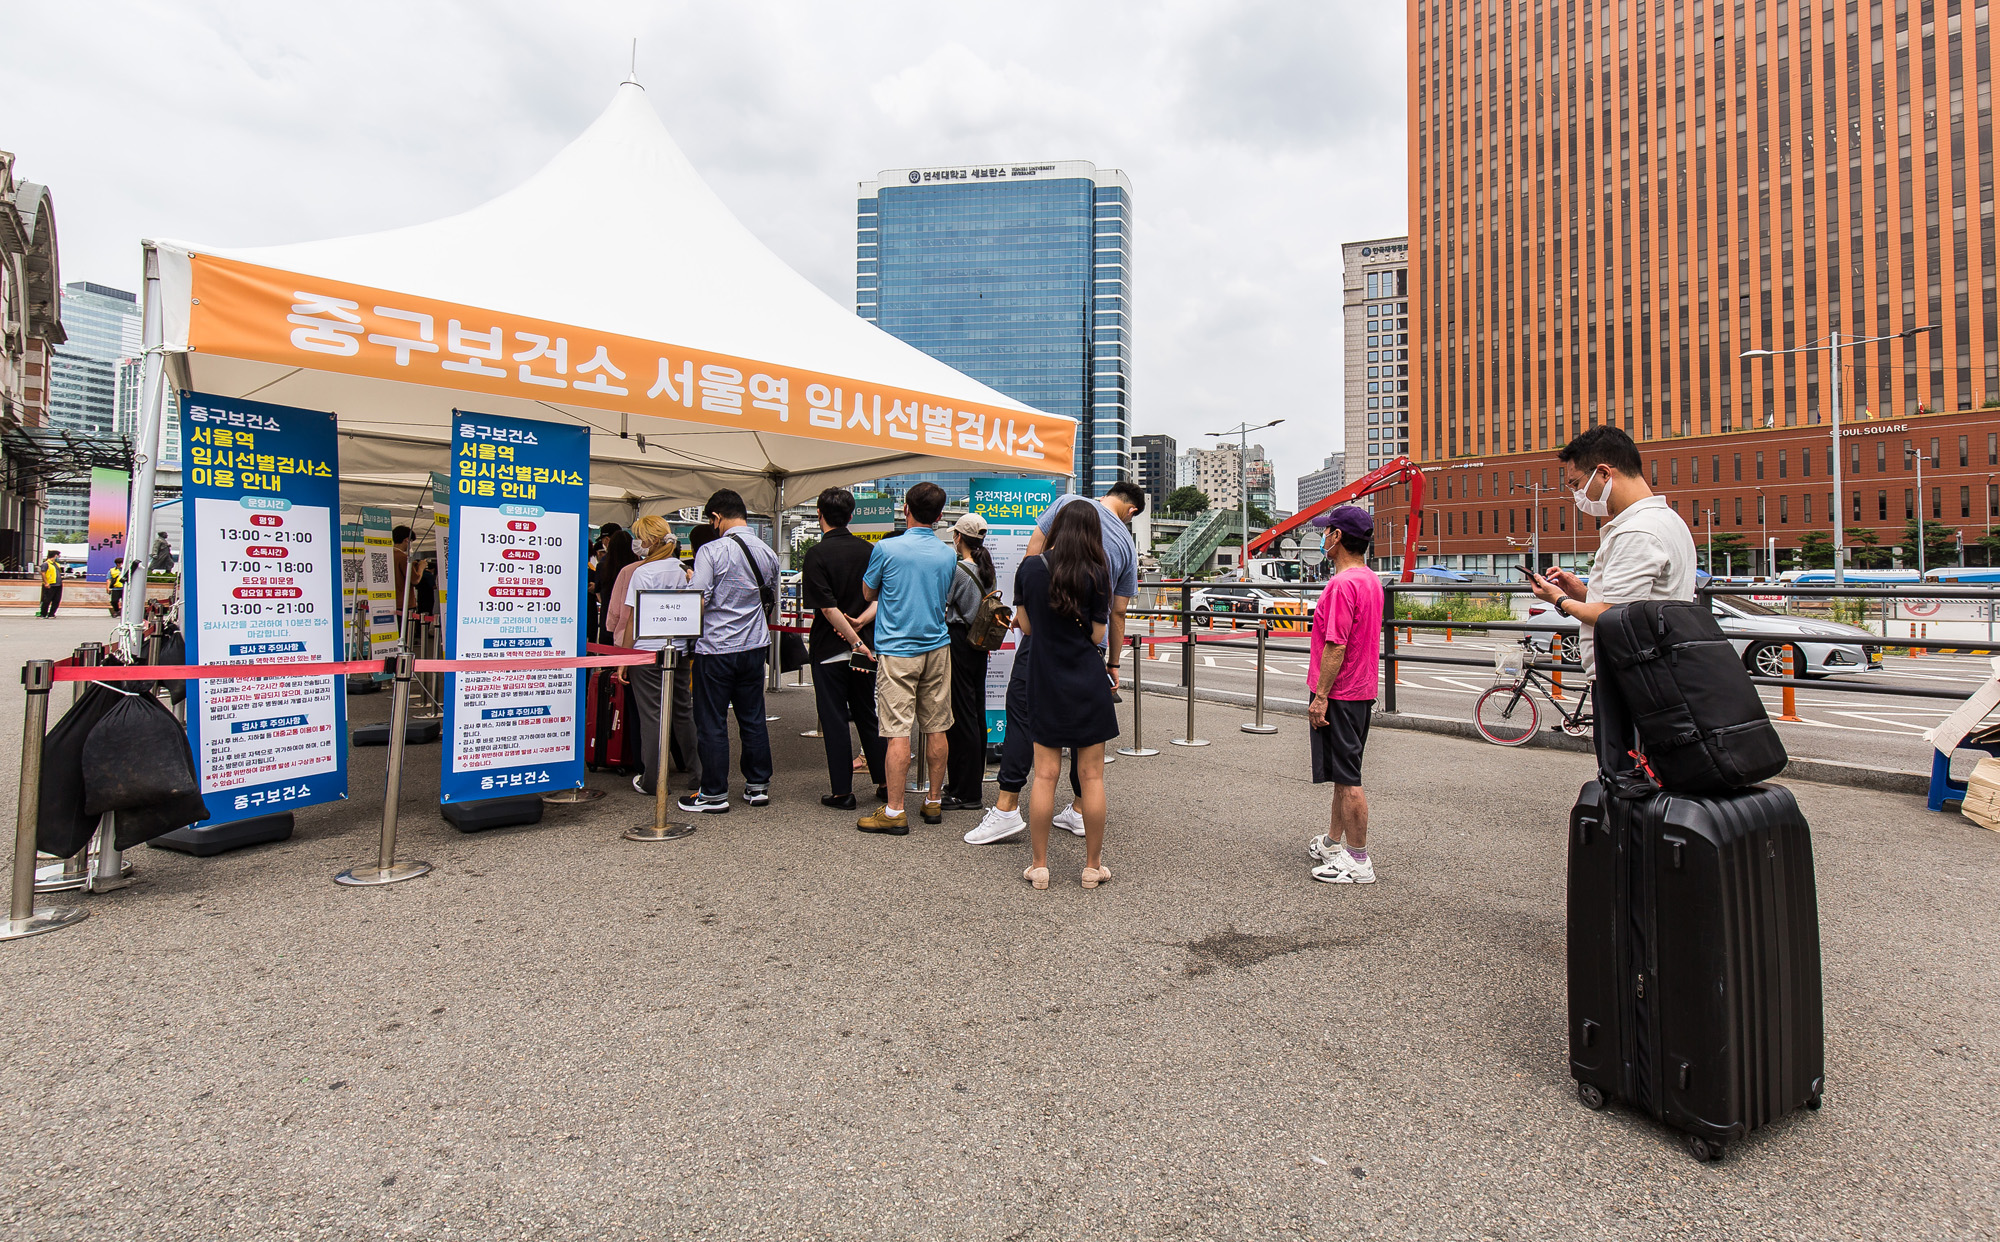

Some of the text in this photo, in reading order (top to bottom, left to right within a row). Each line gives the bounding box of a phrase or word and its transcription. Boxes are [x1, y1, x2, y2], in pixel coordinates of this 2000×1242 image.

[922, 168, 1006, 182] 연세대학교 세브란스
[288, 291, 1047, 462] 중구보건소 서울역 임시선별검사소
[190, 405, 280, 432] 중구보건소
[459, 424, 538, 445] 중구보건소
[1829, 424, 1908, 438] SOUL SQUARE
[190, 426, 254, 450] 서울역
[459, 442, 514, 462] 서울역
[190, 446, 333, 478] 임시선별검사소
[458, 460, 584, 486] 임시선별검사소
[191, 468, 281, 492] 이용 안내
[458, 478, 536, 500] 이용 안내
[974, 490, 1052, 502] 유전자검사 (PCR)
[248, 498, 284, 510] 운영시간
[506, 505, 538, 516] 운영시간
[864, 506, 877, 516] 검사
[878, 506, 892, 515] 접수
[974, 504, 1023, 518] 우선순위
[258, 516, 276, 526] 평일
[514, 522, 530, 530] 평일
[220, 528, 260, 541] 13:00
[275, 531, 312, 544] 21:00
[480, 533, 516, 544] 13:00
[528, 536, 562, 547] 21:00
[252, 548, 283, 556] 소독시간
[508, 550, 534, 560] 소독시간
[220, 560, 260, 573] 17:00
[276, 562, 313, 574] 18:00
[480, 562, 514, 574] 17:00
[528, 564, 562, 575] 18:00
[242, 576, 294, 586] 토요일 미운영
[498, 576, 544, 586] 토요일 미운영
[240, 588, 296, 598] 일요일 및 공휴일
[496, 588, 516, 596] 일요일
[525, 588, 545, 596] 공휴일
[222, 603, 262, 615] 13:00
[276, 602, 314, 614] 21:00
[478, 601, 514, 612] 13:00
[527, 602, 561, 612] 21:00
[203, 618, 328, 630] 검사시간을 고려하여 10분전 접수
[462, 616, 574, 625] 검사시간을 고려하여 10분전 접수
[247, 630, 290, 638] 마감합니다.
[500, 625, 538, 634] 마감합니다.
[240, 643, 298, 654] 검사 전 주의사항
[492, 638, 546, 648] 검사 전 주의사항
[464, 684, 502, 692] 검사결과지는
[210, 694, 252, 705] 검사결과지는
[490, 707, 544, 718] 검사 후 주의사항
[242, 717, 301, 732] 검사 후 주의사항
[272, 728, 298, 738] 대중교통
[480, 770, 550, 790] 중구보건소
[234, 784, 312, 810] 중구보건소
